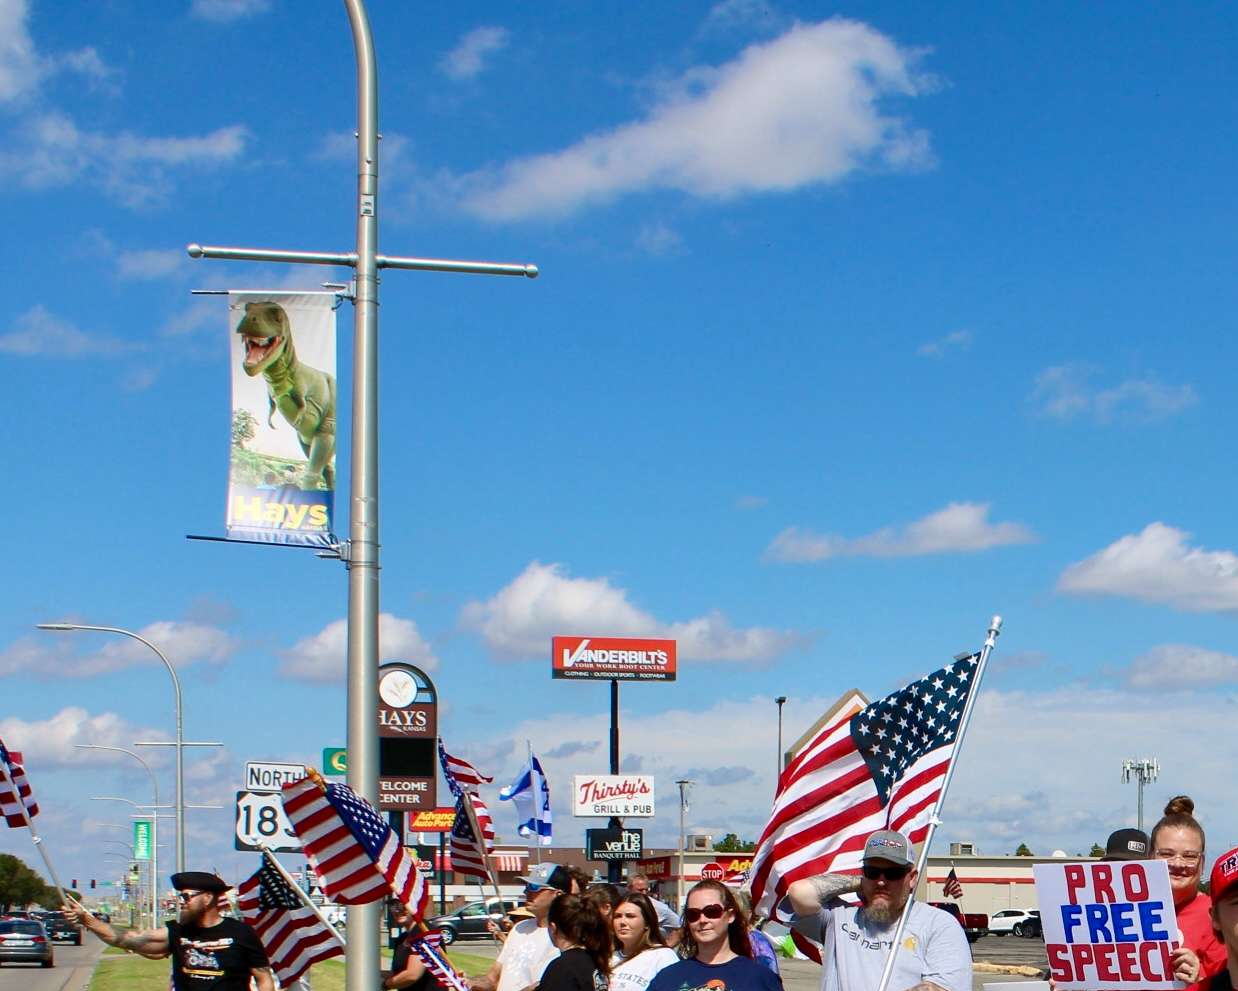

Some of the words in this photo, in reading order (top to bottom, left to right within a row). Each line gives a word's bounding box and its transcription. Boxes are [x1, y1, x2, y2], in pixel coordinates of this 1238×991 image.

[234, 495, 329, 530] Hays
[563, 639, 668, 667] VANDERBILT'S
[249, 767, 302, 787] NORTH
[380, 781, 428, 791] ELCOME
[580, 778, 650, 804] Thirsty's
[593, 804, 621, 814] GRILL
[623, 804, 630, 814] &
[633, 804, 652, 814] PUB
[243, 804, 299, 838] 18
[412, 820, 434, 828] Auto
[606, 841, 640, 852] venue
[622, 830, 640, 843] the
[702, 868, 722, 880] STOP
[1063, 864, 1150, 905] PRO
[1061, 901, 1169, 943] FREE
